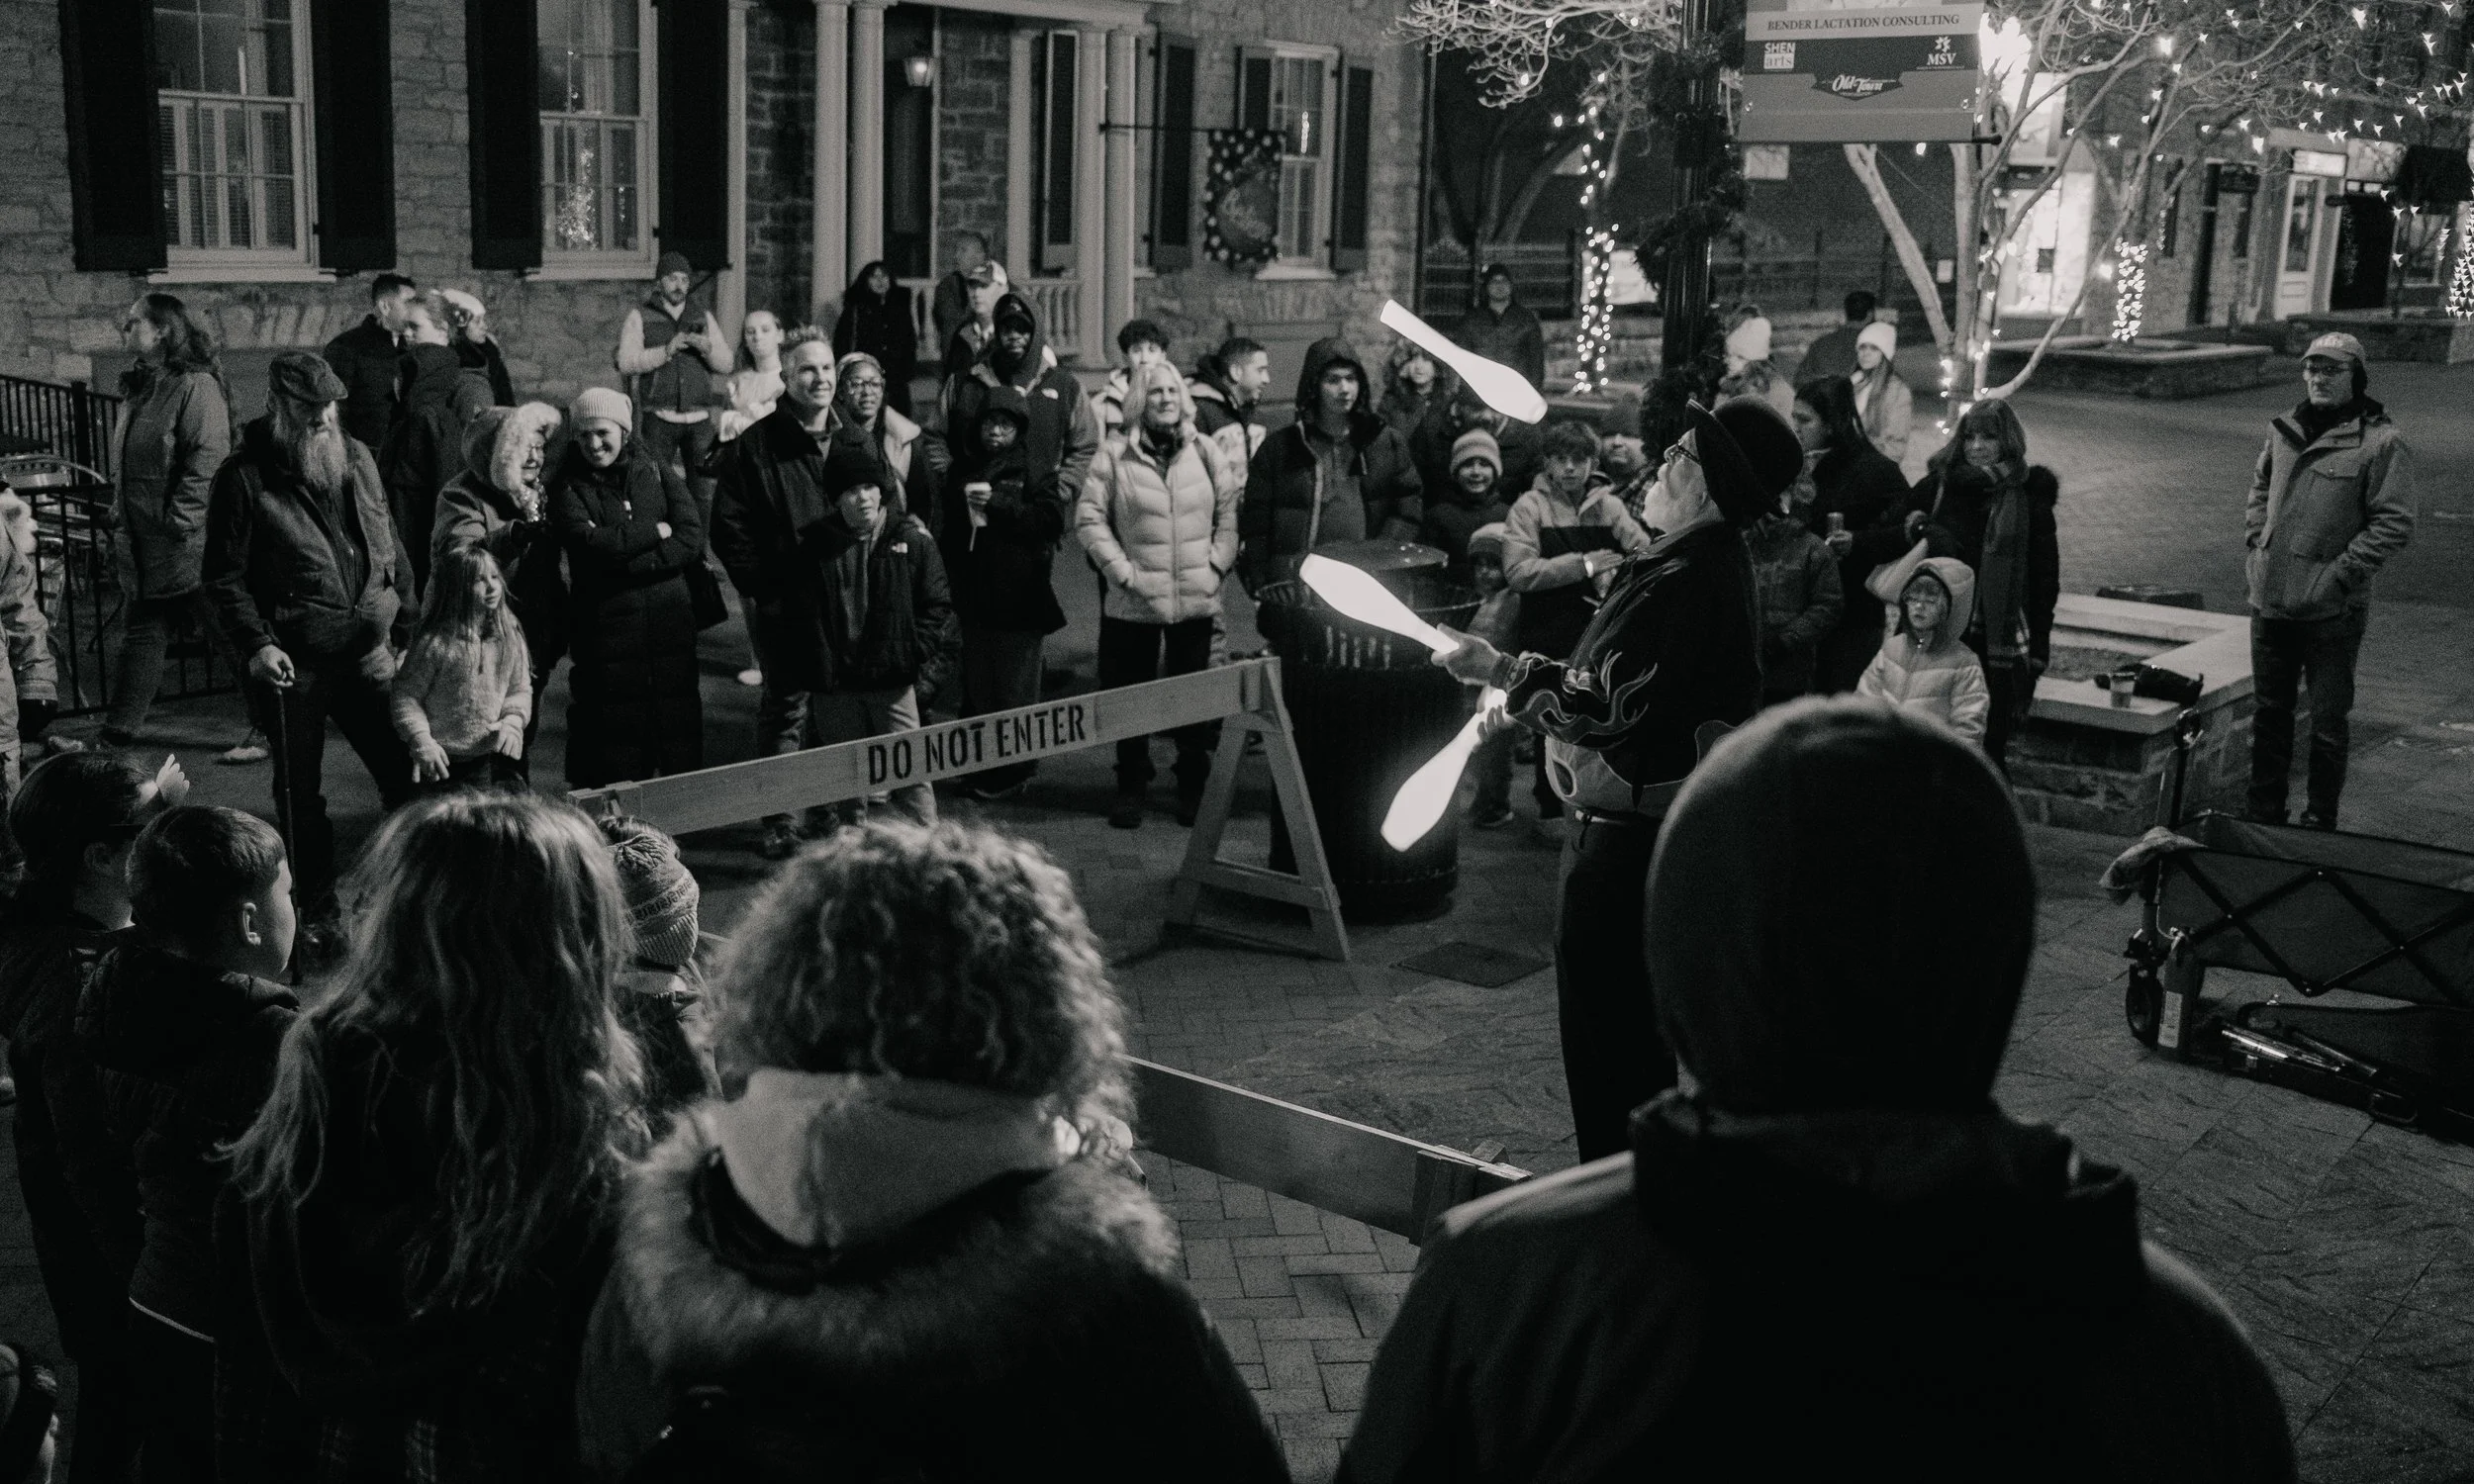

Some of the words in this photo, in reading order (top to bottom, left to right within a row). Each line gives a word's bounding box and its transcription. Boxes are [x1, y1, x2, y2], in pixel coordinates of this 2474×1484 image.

[1767, 19, 1812, 31] BENDER
[1814, 16, 1879, 30] LACTATION
[1882, 14, 1960, 28] CONSULTING
[1764, 42, 1796, 54] SHEN
[1927, 52, 1956, 65] MSV
[1832, 74, 1856, 92] Old
[1854, 78, 1883, 93] Town
[868, 739, 912, 786] DO
[925, 721, 986, 774] NOT
[996, 703, 1086, 758] ENTER
